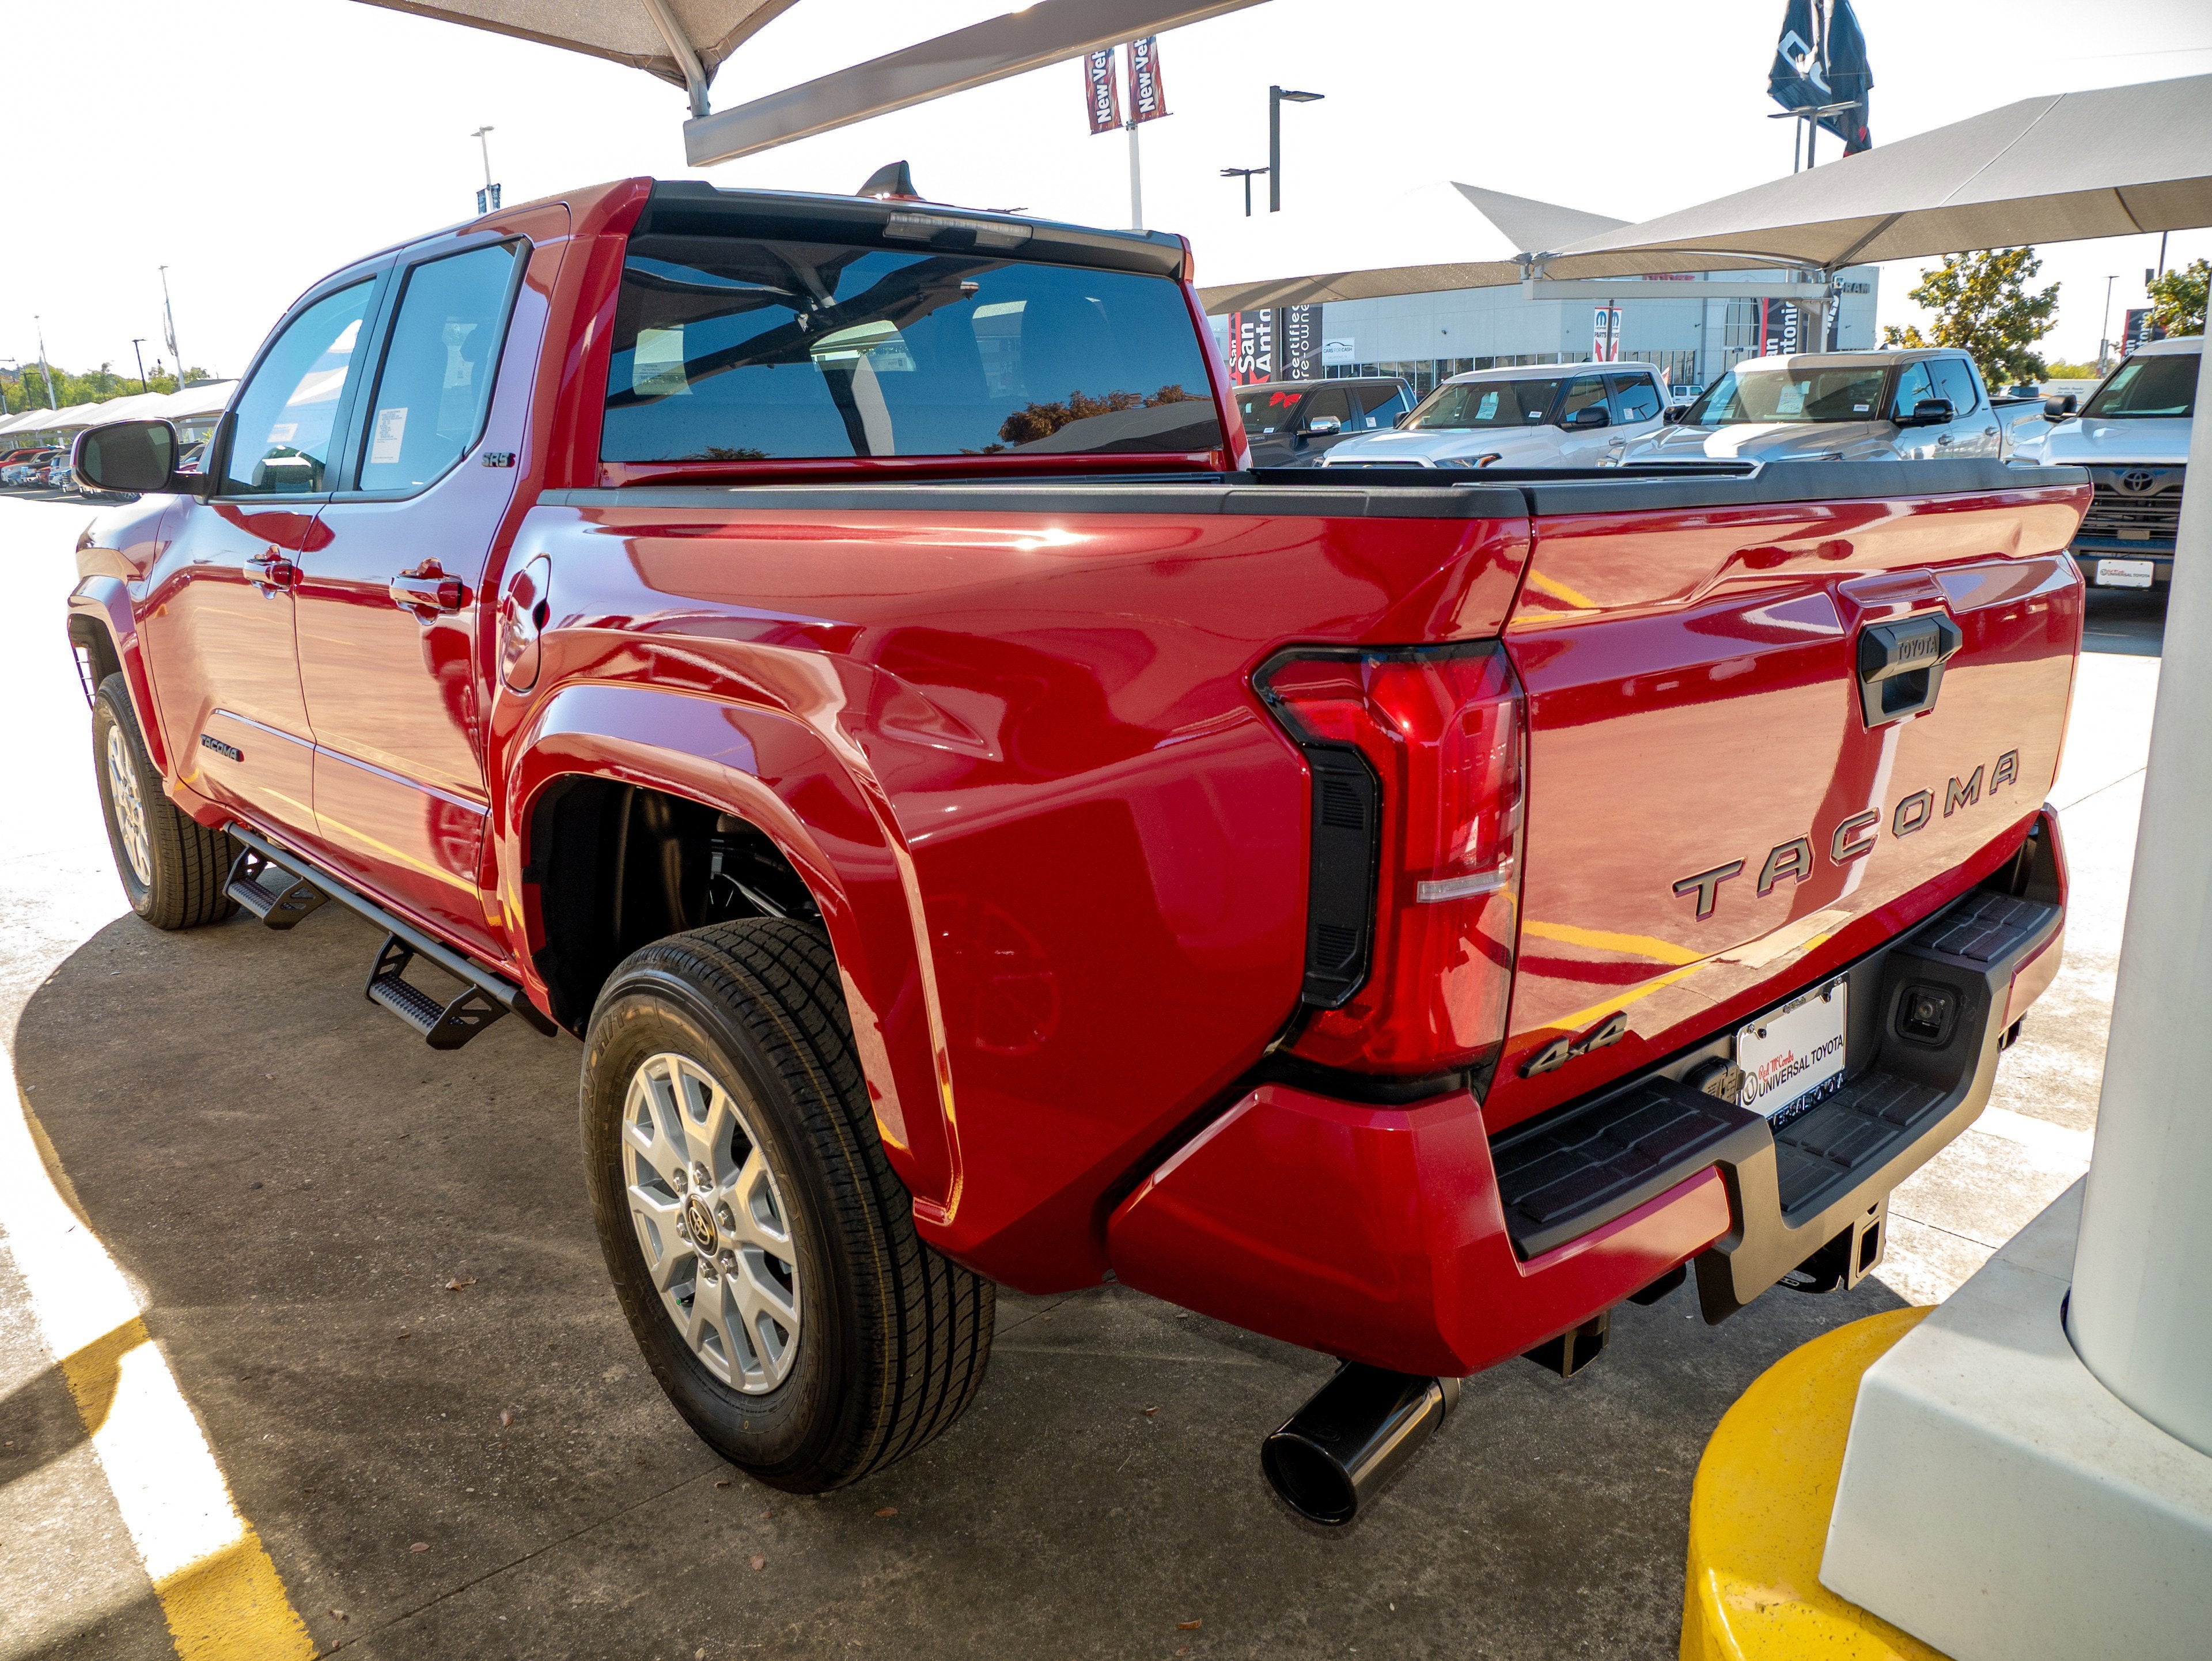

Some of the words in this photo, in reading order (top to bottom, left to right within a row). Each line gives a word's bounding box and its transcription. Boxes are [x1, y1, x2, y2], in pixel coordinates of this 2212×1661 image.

[1096, 84, 1112, 124] New
[1138, 73, 1156, 113] New
[1843, 282, 1870, 293] RAM
[1238, 322, 1255, 374] San
[1897, 635, 1937, 660] TOYOTA
[200, 734, 240, 762] TACOMA
[1672, 748, 2020, 922] TACOMA
[1759, 1055, 1810, 1098] UNIVERSAL
[1811, 1034, 1843, 1065] TOYOTA
[1759, 1062, 1770, 1083] Red
